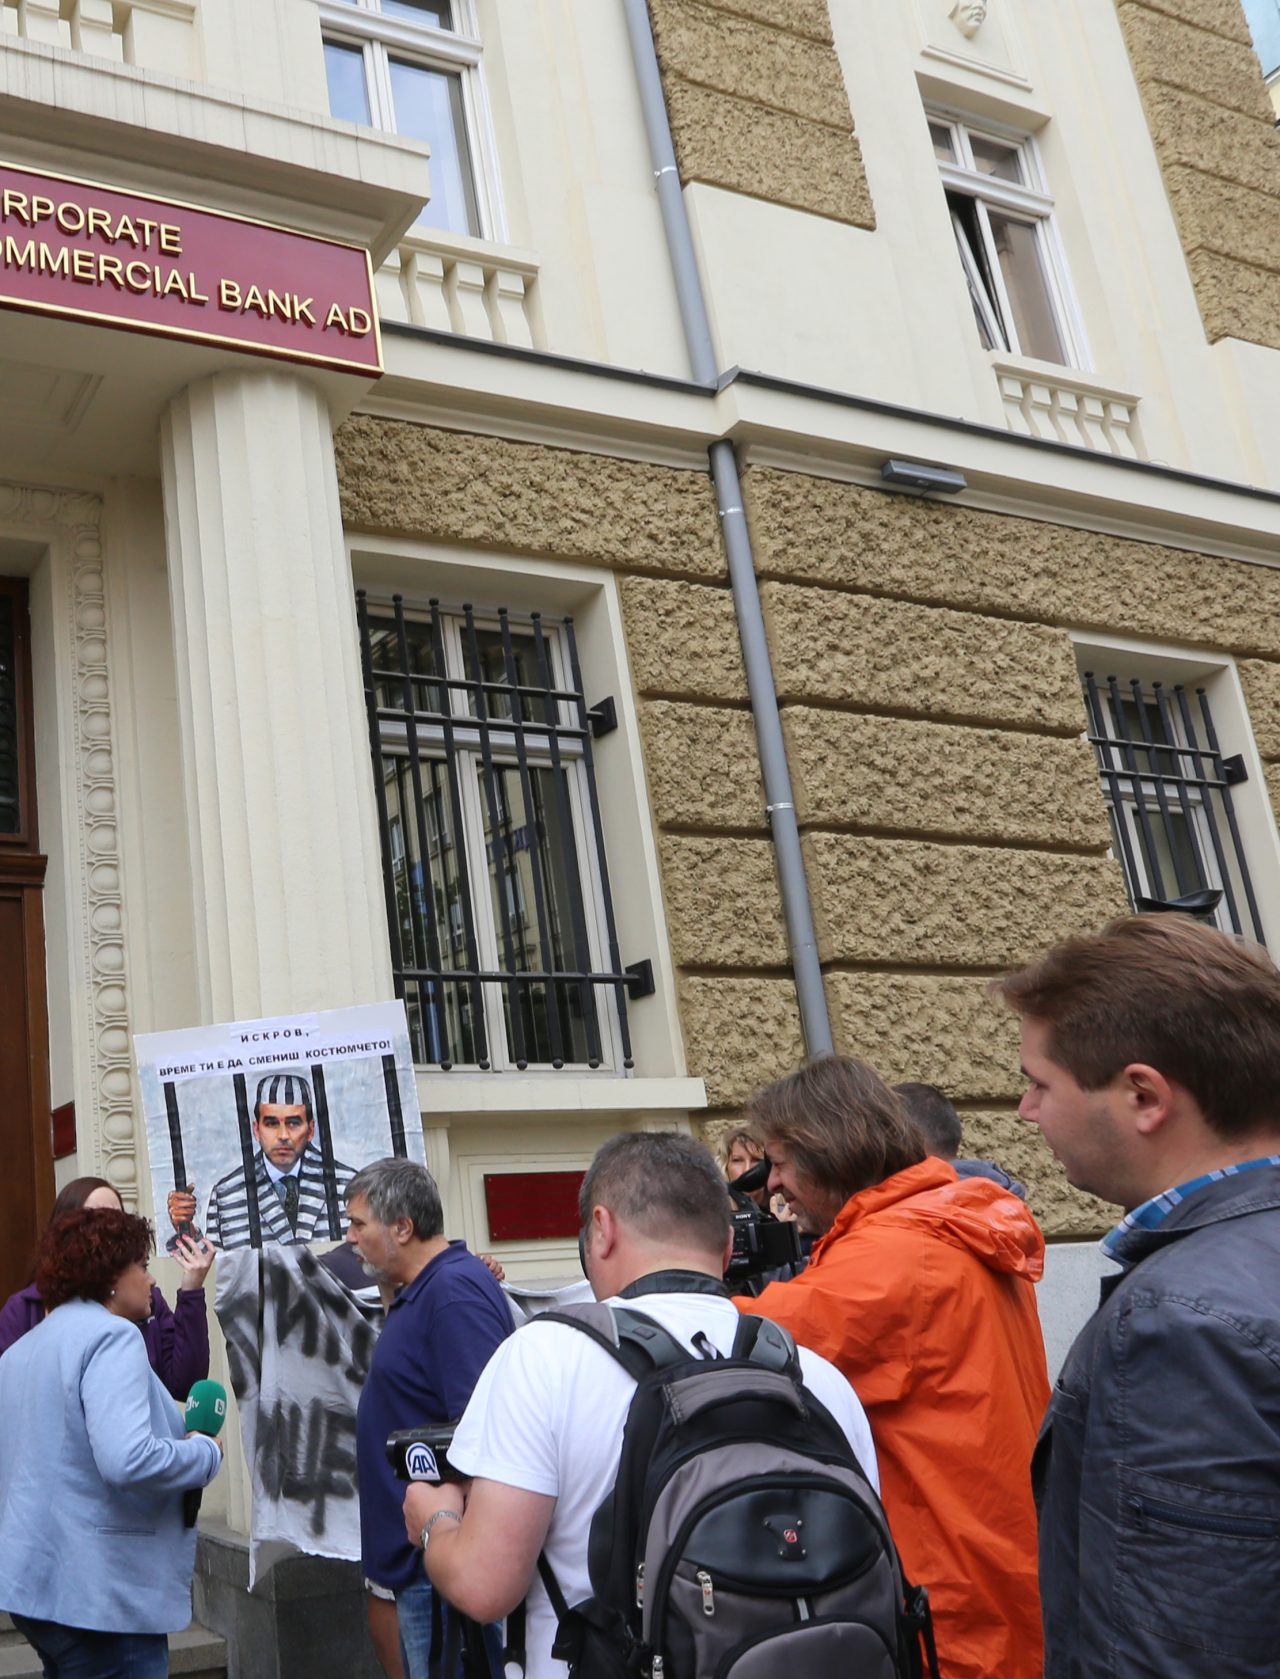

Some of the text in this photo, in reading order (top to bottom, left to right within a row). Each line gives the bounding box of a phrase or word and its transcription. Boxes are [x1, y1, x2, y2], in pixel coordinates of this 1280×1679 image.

[220, 278, 317, 325] BANK
[326, 302, 372, 337] AD
[240, 1028, 310, 1043] ИСКРОВ,
[159, 1040, 391, 1076] ВРЕМЕ ТИ Е ДА СМЕНИШ КОСТЮМЧЕТО!
[412, 1455, 436, 1474] AA
